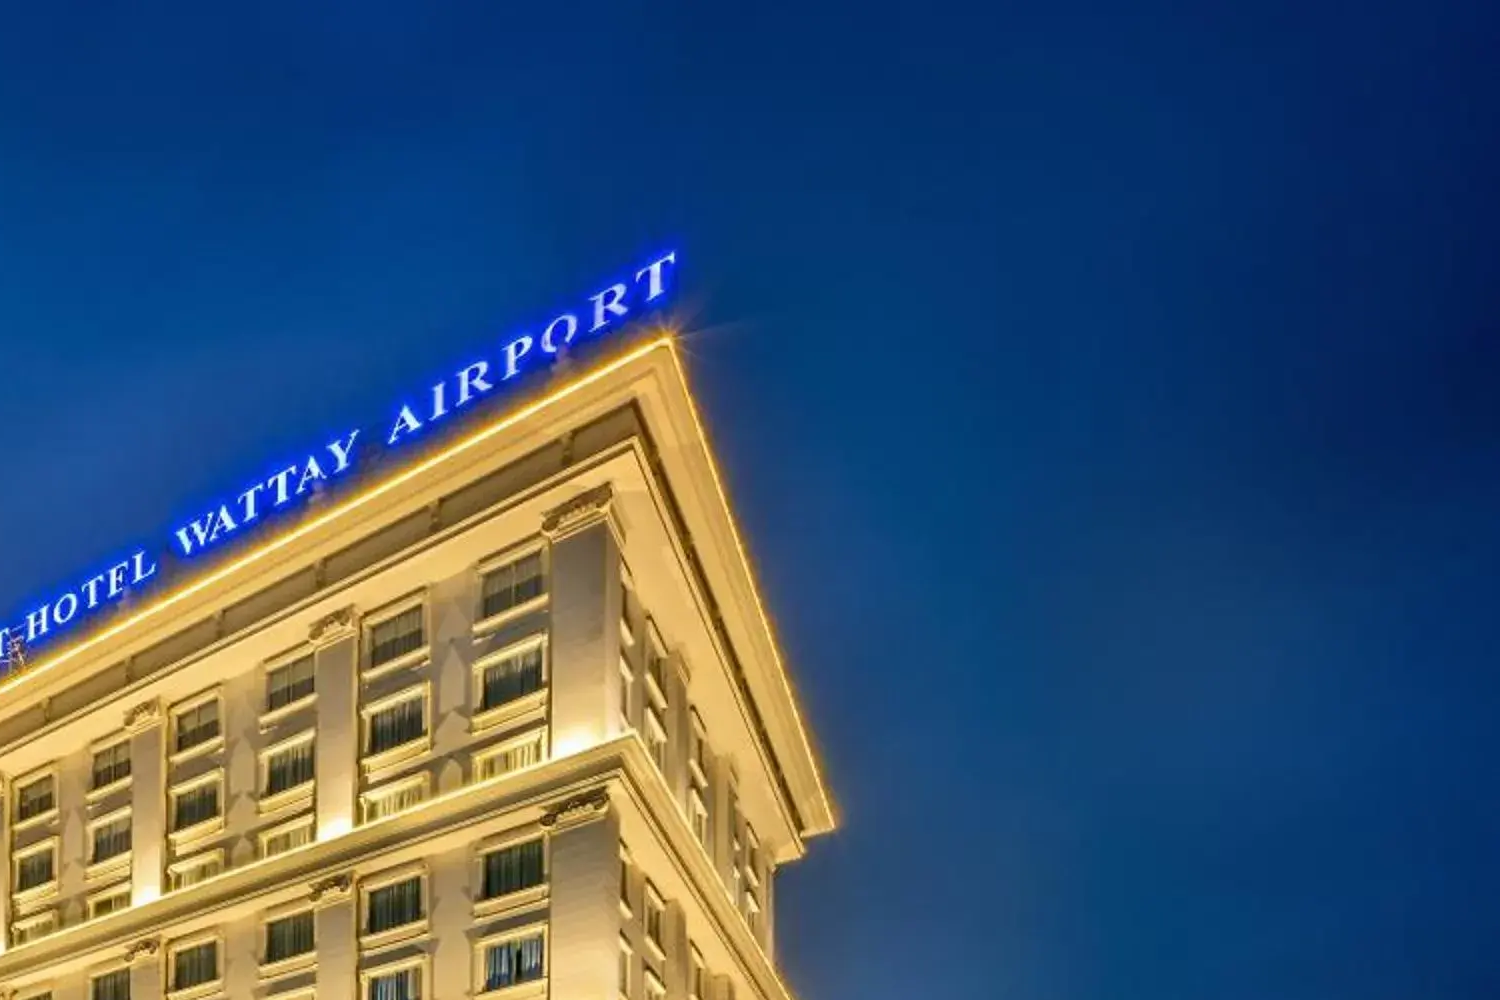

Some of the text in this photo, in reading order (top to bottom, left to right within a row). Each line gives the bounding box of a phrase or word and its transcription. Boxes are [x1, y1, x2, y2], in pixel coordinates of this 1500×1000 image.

[25, 550, 156, 642] HOTEL
[175, 428, 360, 555] WATTAY
[387, 251, 676, 444] AIRPORT
